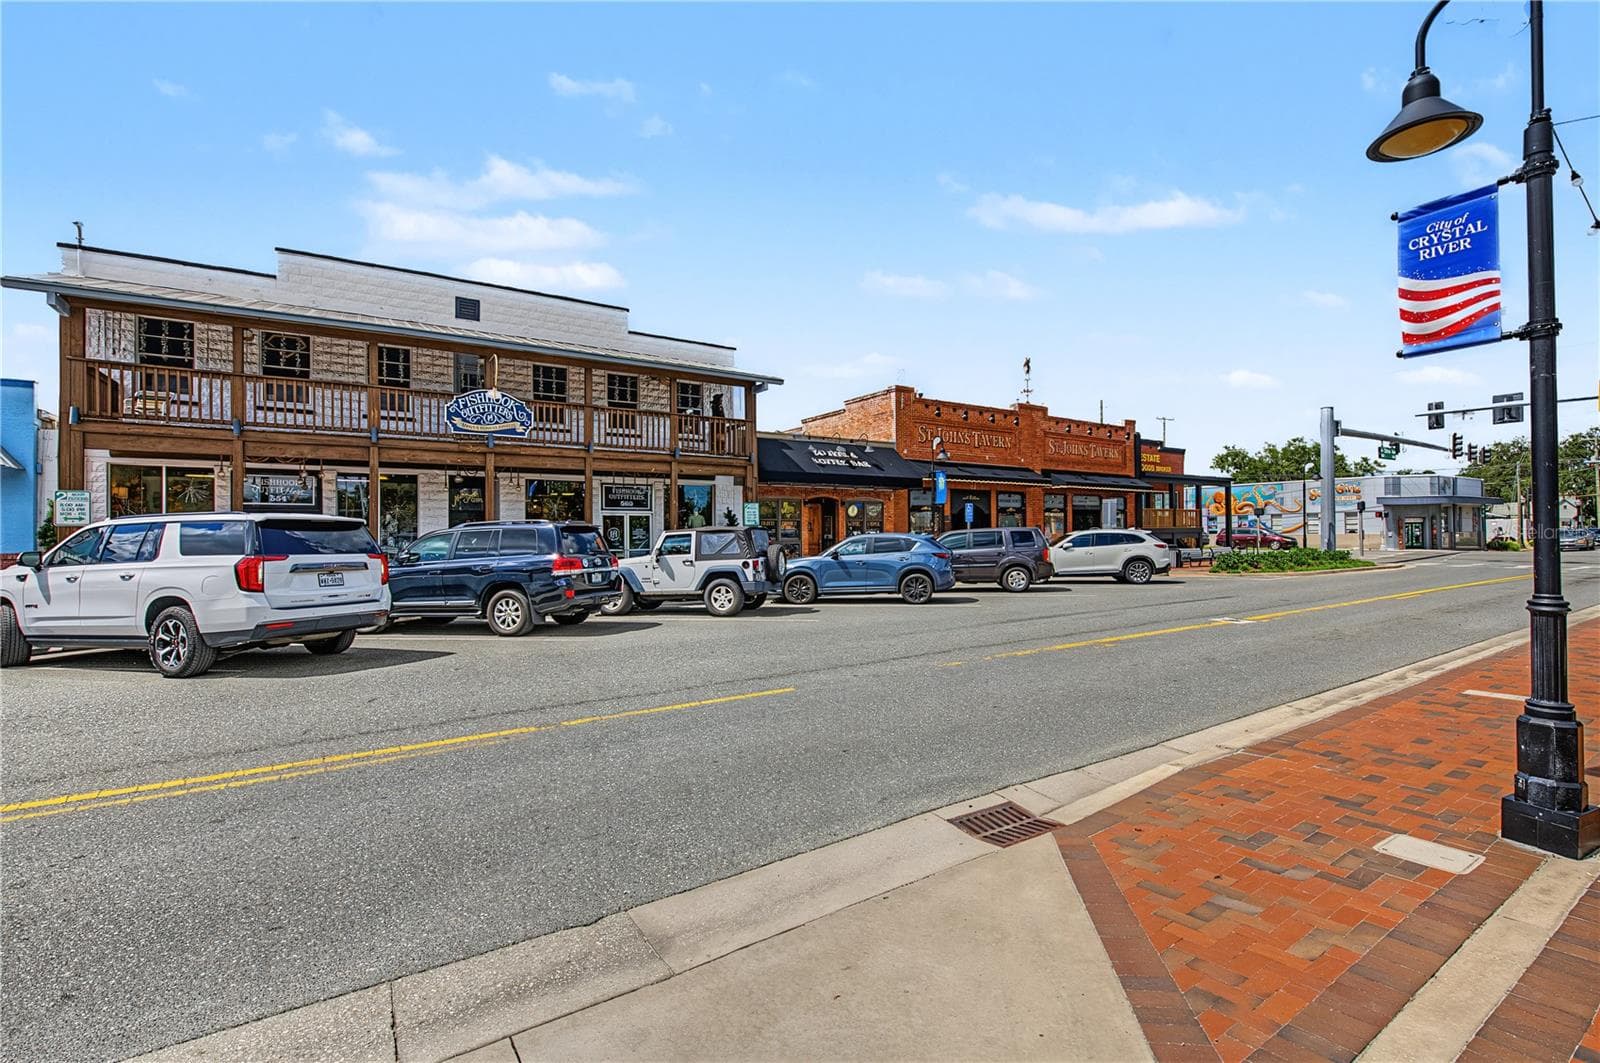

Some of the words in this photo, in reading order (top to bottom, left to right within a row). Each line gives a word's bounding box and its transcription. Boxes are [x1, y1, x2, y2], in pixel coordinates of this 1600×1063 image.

[1426, 219, 1452, 234] City
[1454, 212, 1470, 226] of
[1408, 220, 1488, 250] CRYSTAL
[1419, 237, 1472, 261] RIVER
[972, 431, 1012, 449] TAVERN
[1089, 444, 1120, 459] TAVERN
